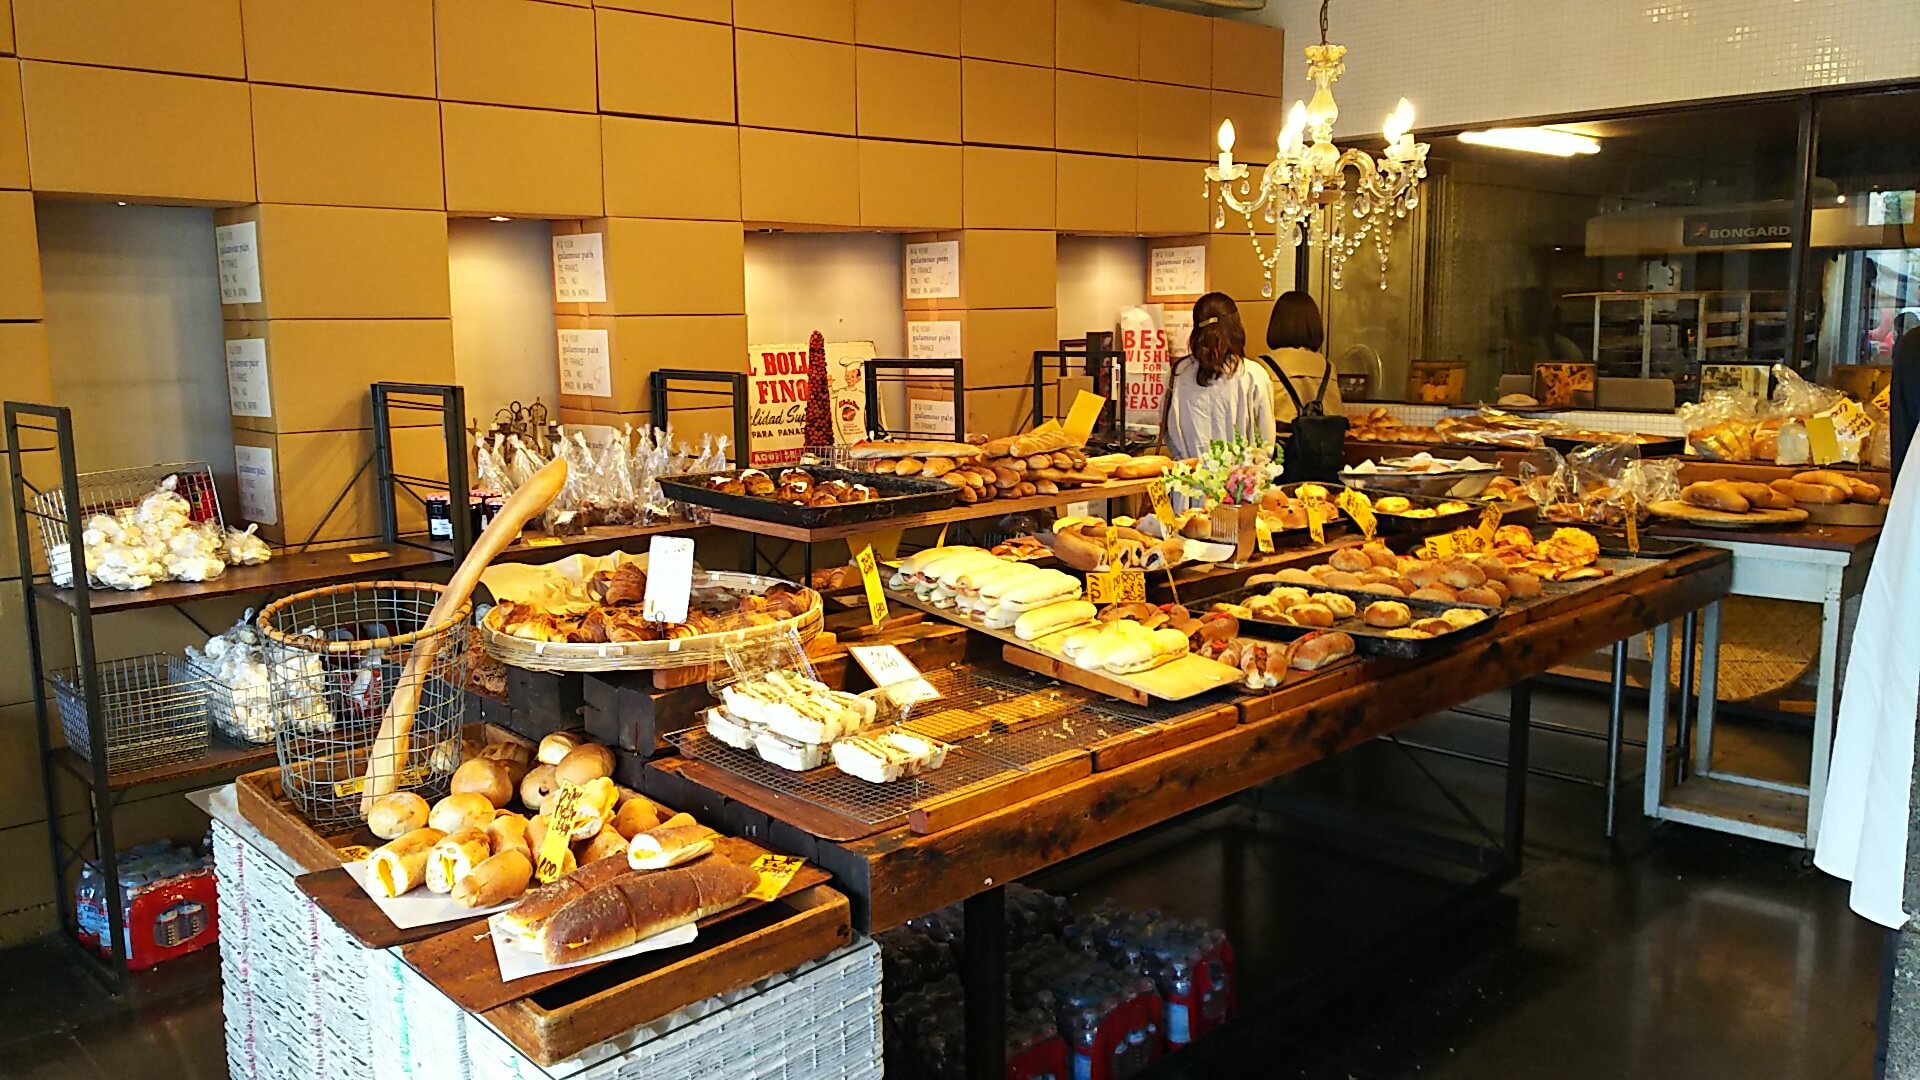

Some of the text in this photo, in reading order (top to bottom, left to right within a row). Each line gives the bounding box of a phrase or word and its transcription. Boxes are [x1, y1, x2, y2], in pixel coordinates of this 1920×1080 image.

[1709, 226, 1791, 239] BONGARD
[1123, 329, 1166, 349] BES
[1124, 350, 1171, 363] WISHE
[747, 351, 809, 377] L BOLL
[1143, 363, 1162, 372] FOR
[1143, 373, 1162, 383] THE
[756, 379, 810, 404] FINO
[750, 404, 807, 427] lidad Sup
[752, 427, 806, 439] PARA PANAD
